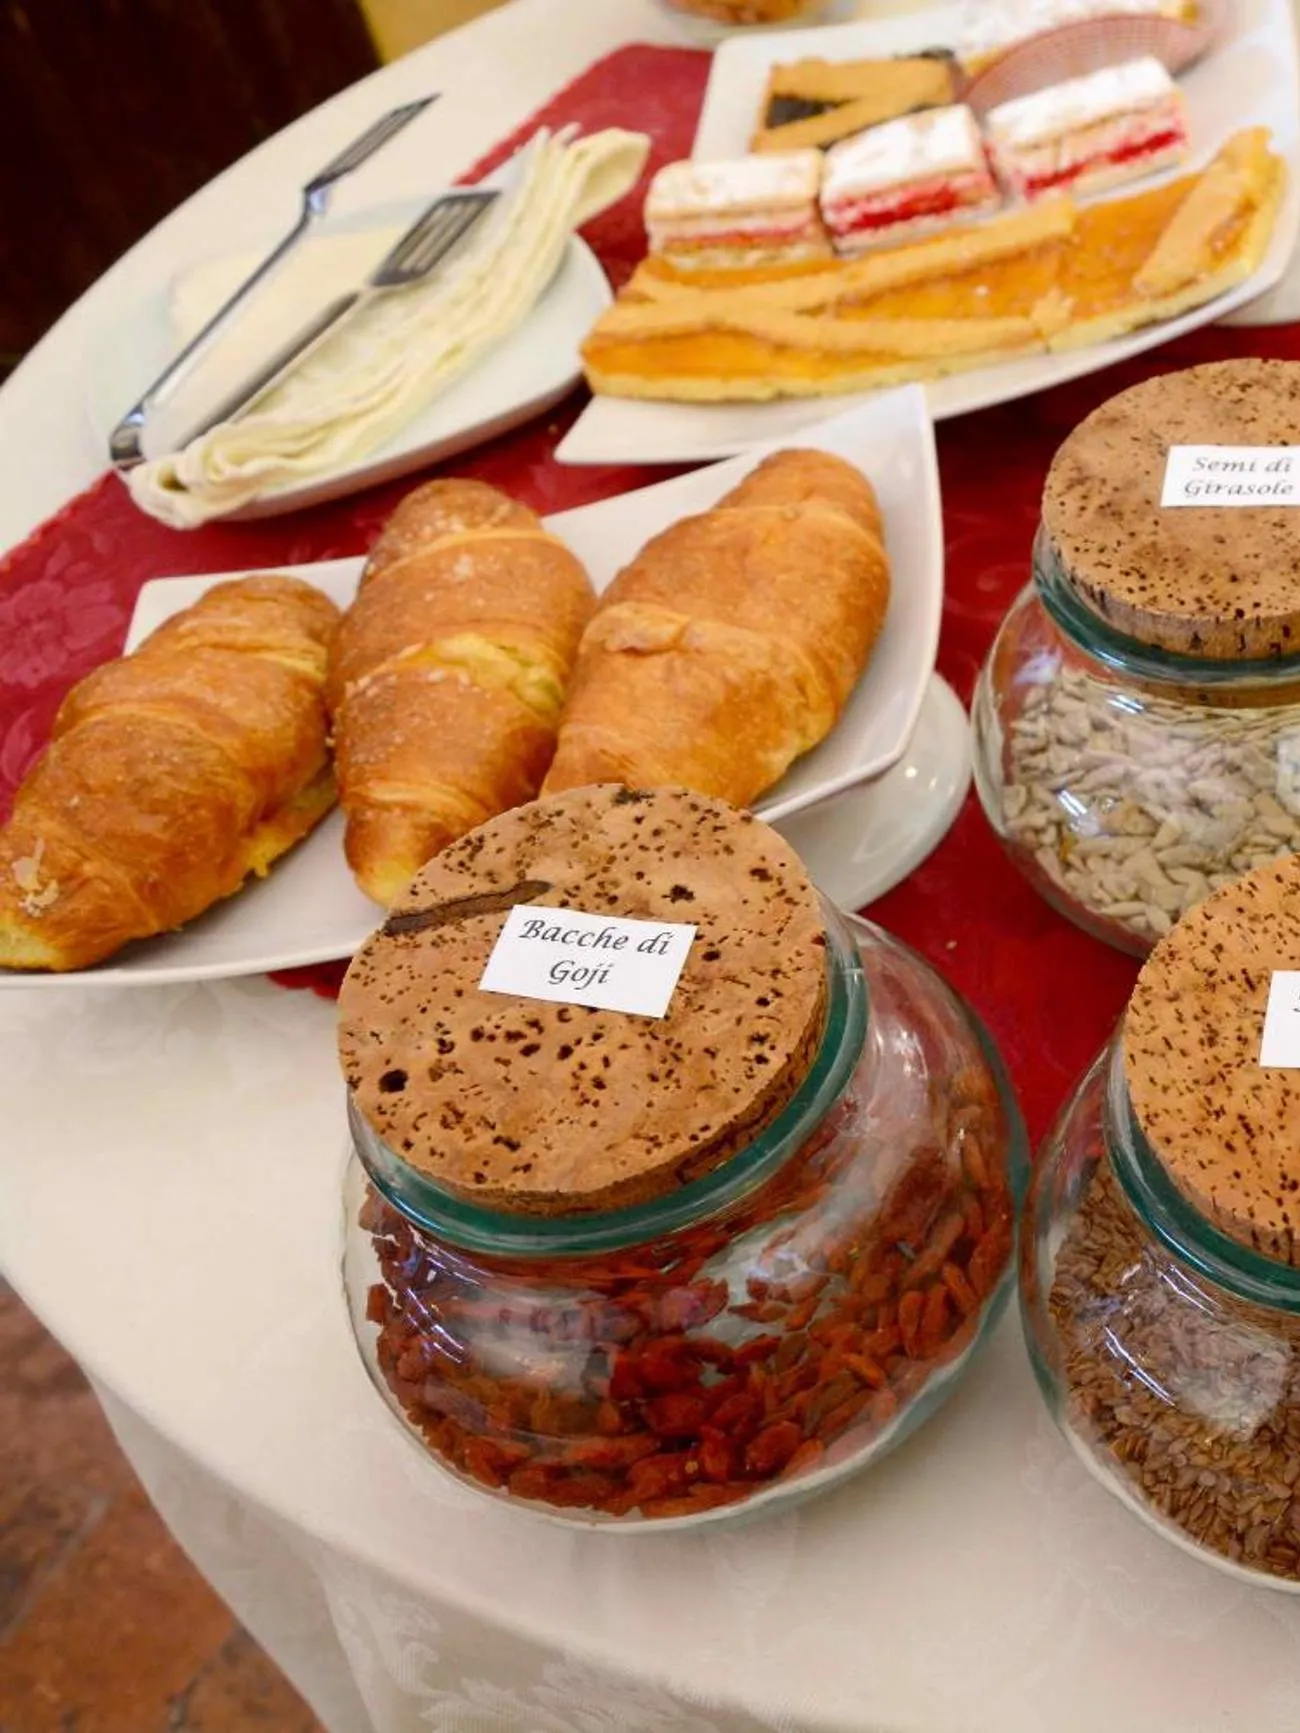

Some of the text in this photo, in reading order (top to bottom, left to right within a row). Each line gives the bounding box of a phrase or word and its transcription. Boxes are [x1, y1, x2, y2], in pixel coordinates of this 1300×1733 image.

[1193, 456, 1293, 473] Semi di
[1184, 478, 1294, 496] Girasole
[519, 919, 673, 955] Bacche di
[548, 960, 615, 990] Goji
